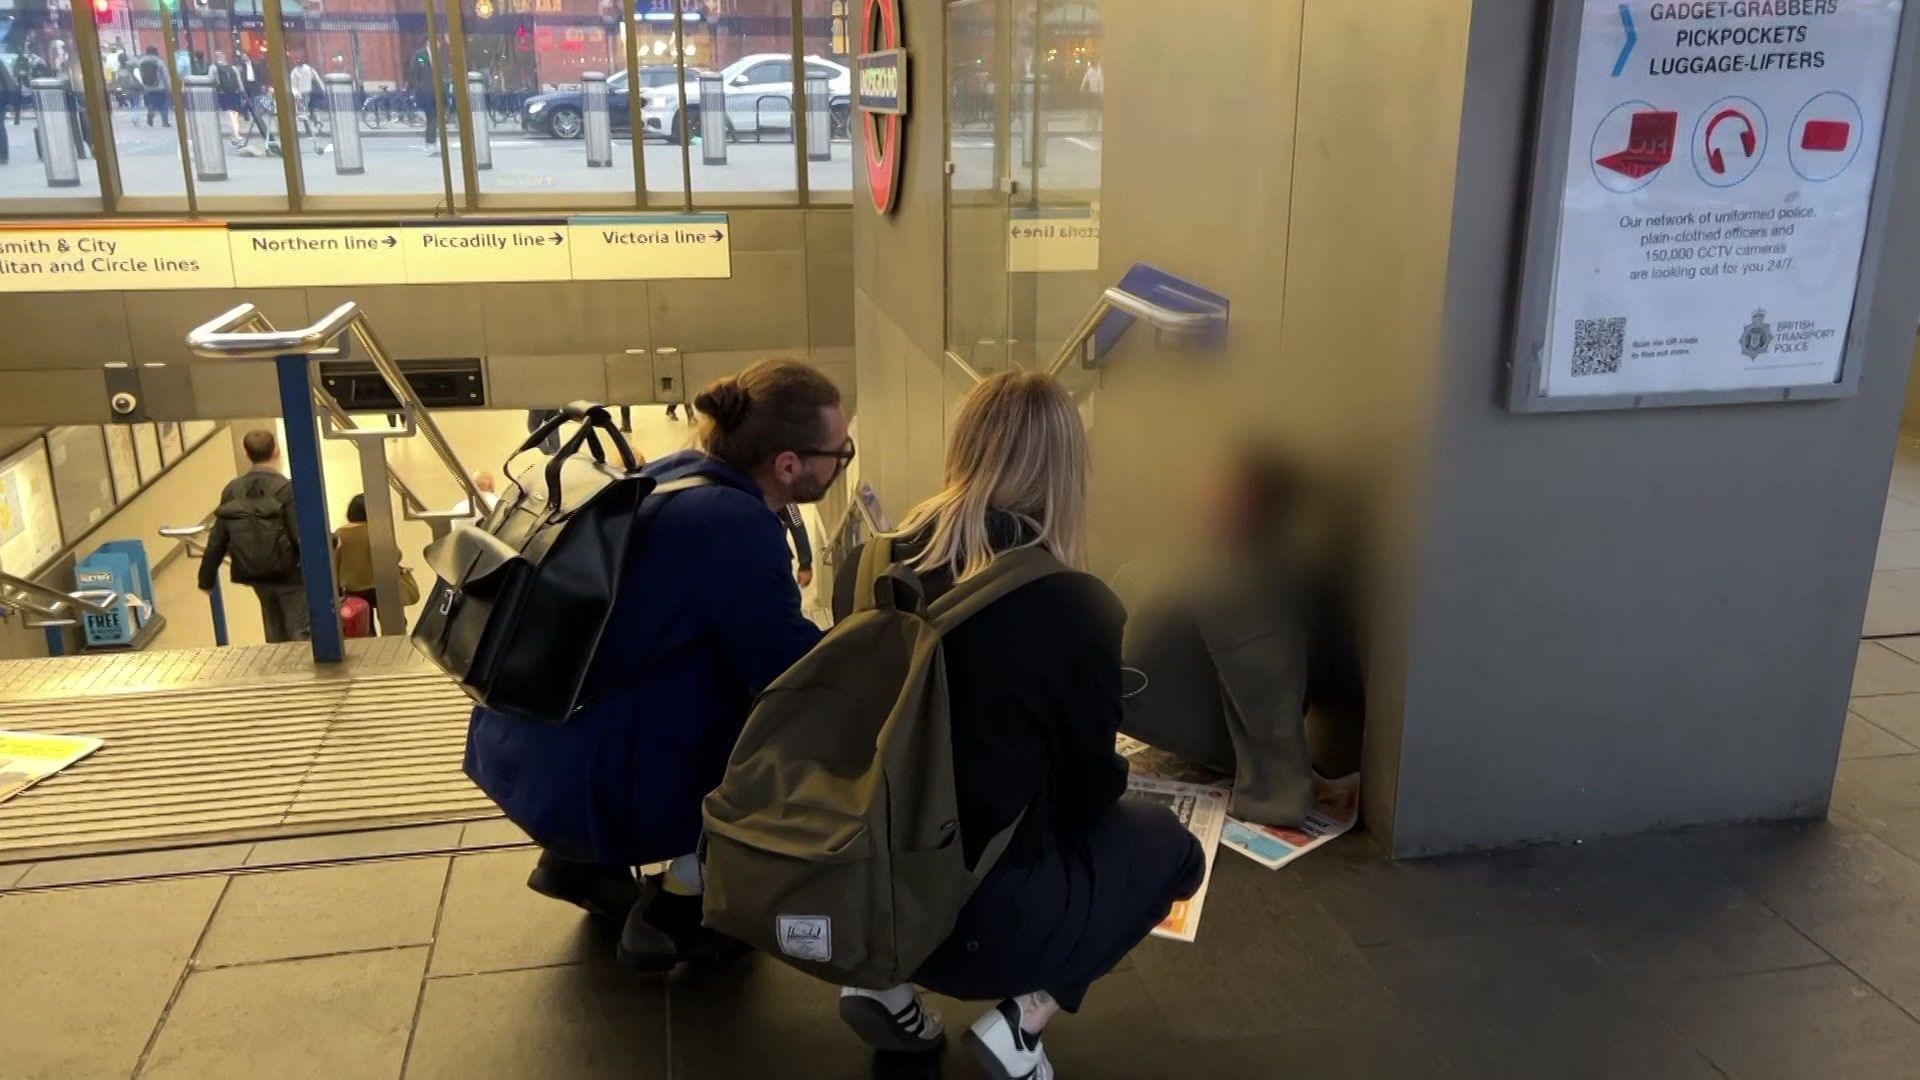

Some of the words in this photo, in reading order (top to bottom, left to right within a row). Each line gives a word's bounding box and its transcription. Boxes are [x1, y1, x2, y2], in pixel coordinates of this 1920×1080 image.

[1650, 0, 1838, 21] GADGET-GRABBERS
[1676, 25, 1808, 48] PICKPOCKETS
[1649, 51, 1825, 76] LUGGAGE-LIFTERS
[1619, 215, 1642, 229] Our
[1646, 213, 1695, 227] network
[1700, 211, 1711, 224] of
[1715, 207, 1774, 224] uniformed
[252, 236, 338, 251] Northern
[345, 236, 378, 250] line
[422, 233, 507, 249] Piccadilly
[513, 232, 545, 246] line
[602, 230, 670, 244] Victoria
[675, 229, 706, 244] line
[1641, 228, 1720, 247] plain-clothed
[1725, 225, 1767, 240] officers
[1771, 224, 1795, 236] and
[57, 238, 71, 253] &
[77, 237, 117, 255] City
[1697, 246, 1734, 259] CCTV
[1736, 243, 1787, 256] cameras
[50, 258, 84, 273] and
[92, 257, 148, 272] Circle
[154, 257, 200, 272] lines
[1629, 269, 1648, 280] are
[1652, 266, 1696, 280] looking
[1700, 264, 1719, 276] out
[1722, 261, 1739, 274] for
[1742, 262, 1764, 275] you
[1776, 320, 1815, 332] BRITISH
[1776, 328, 1835, 342] TRANSPORT
[1774, 341, 1809, 353] POLICE
